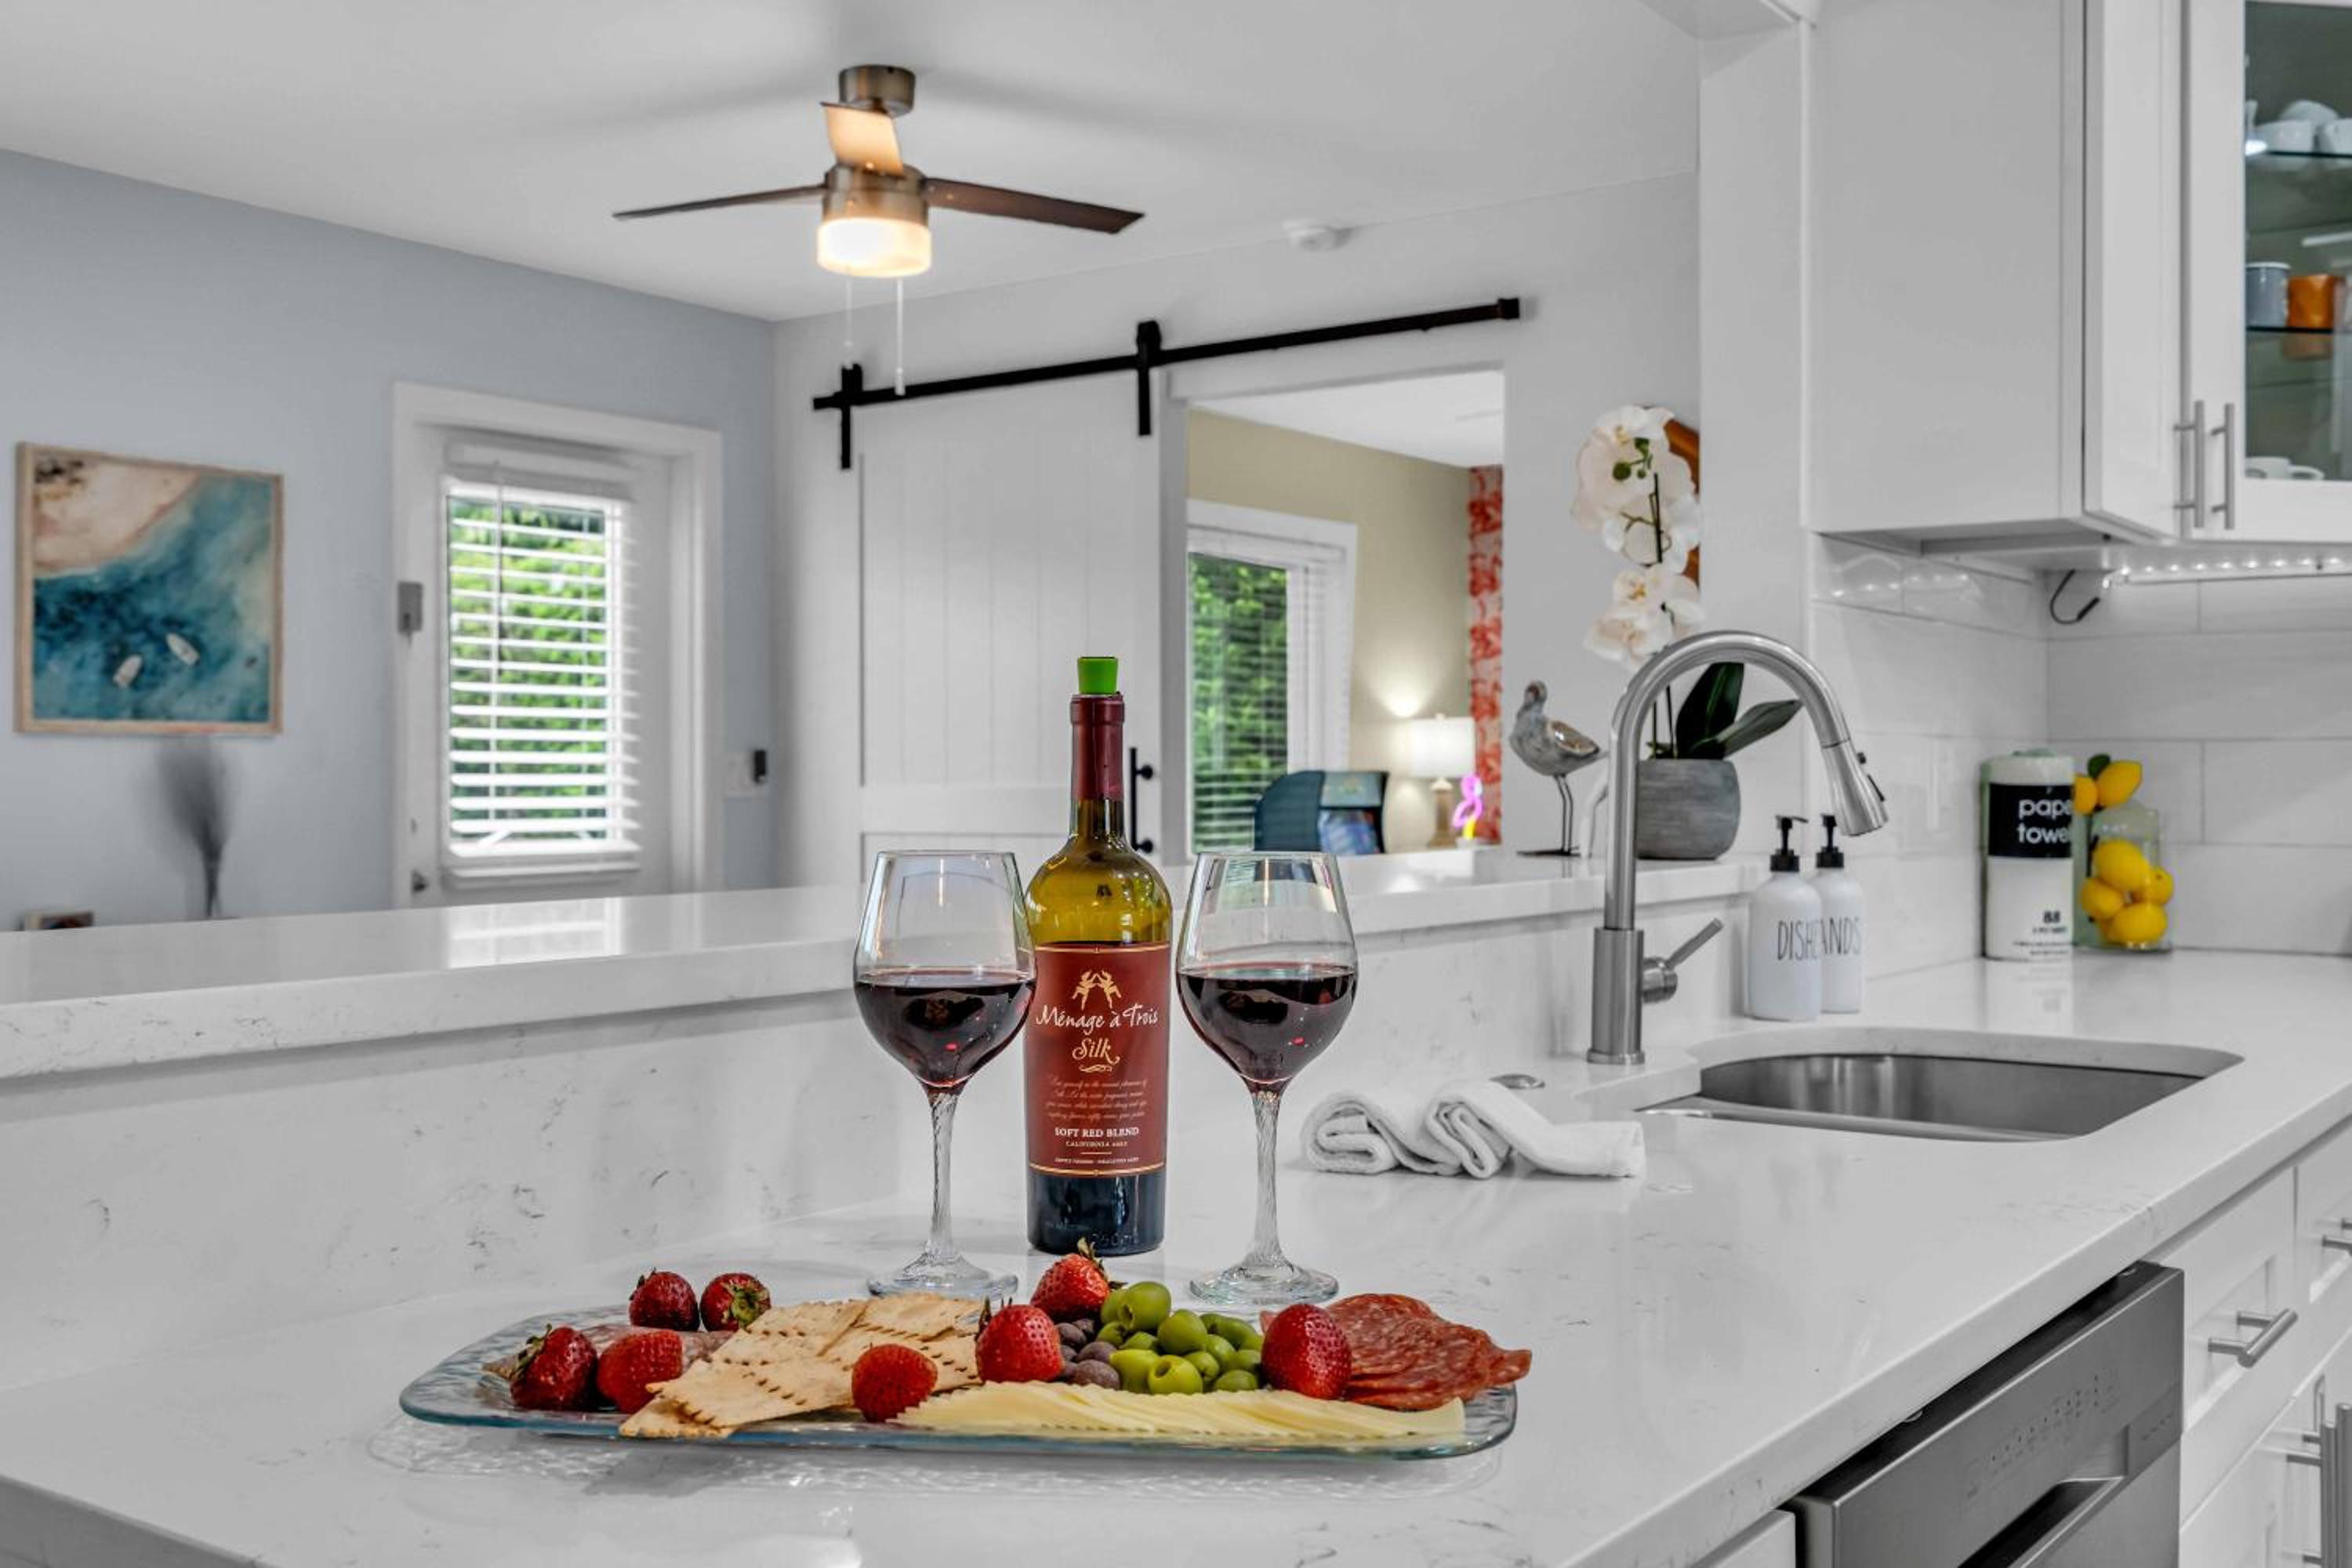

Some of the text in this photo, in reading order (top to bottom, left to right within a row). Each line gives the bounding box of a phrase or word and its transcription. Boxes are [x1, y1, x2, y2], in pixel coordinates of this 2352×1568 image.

[1036, 1003, 1159, 1036] Ménage à Trois
[1072, 1037, 1120, 1065] Silk
[1054, 1127, 1139, 1138] SOFT RED BLEND
